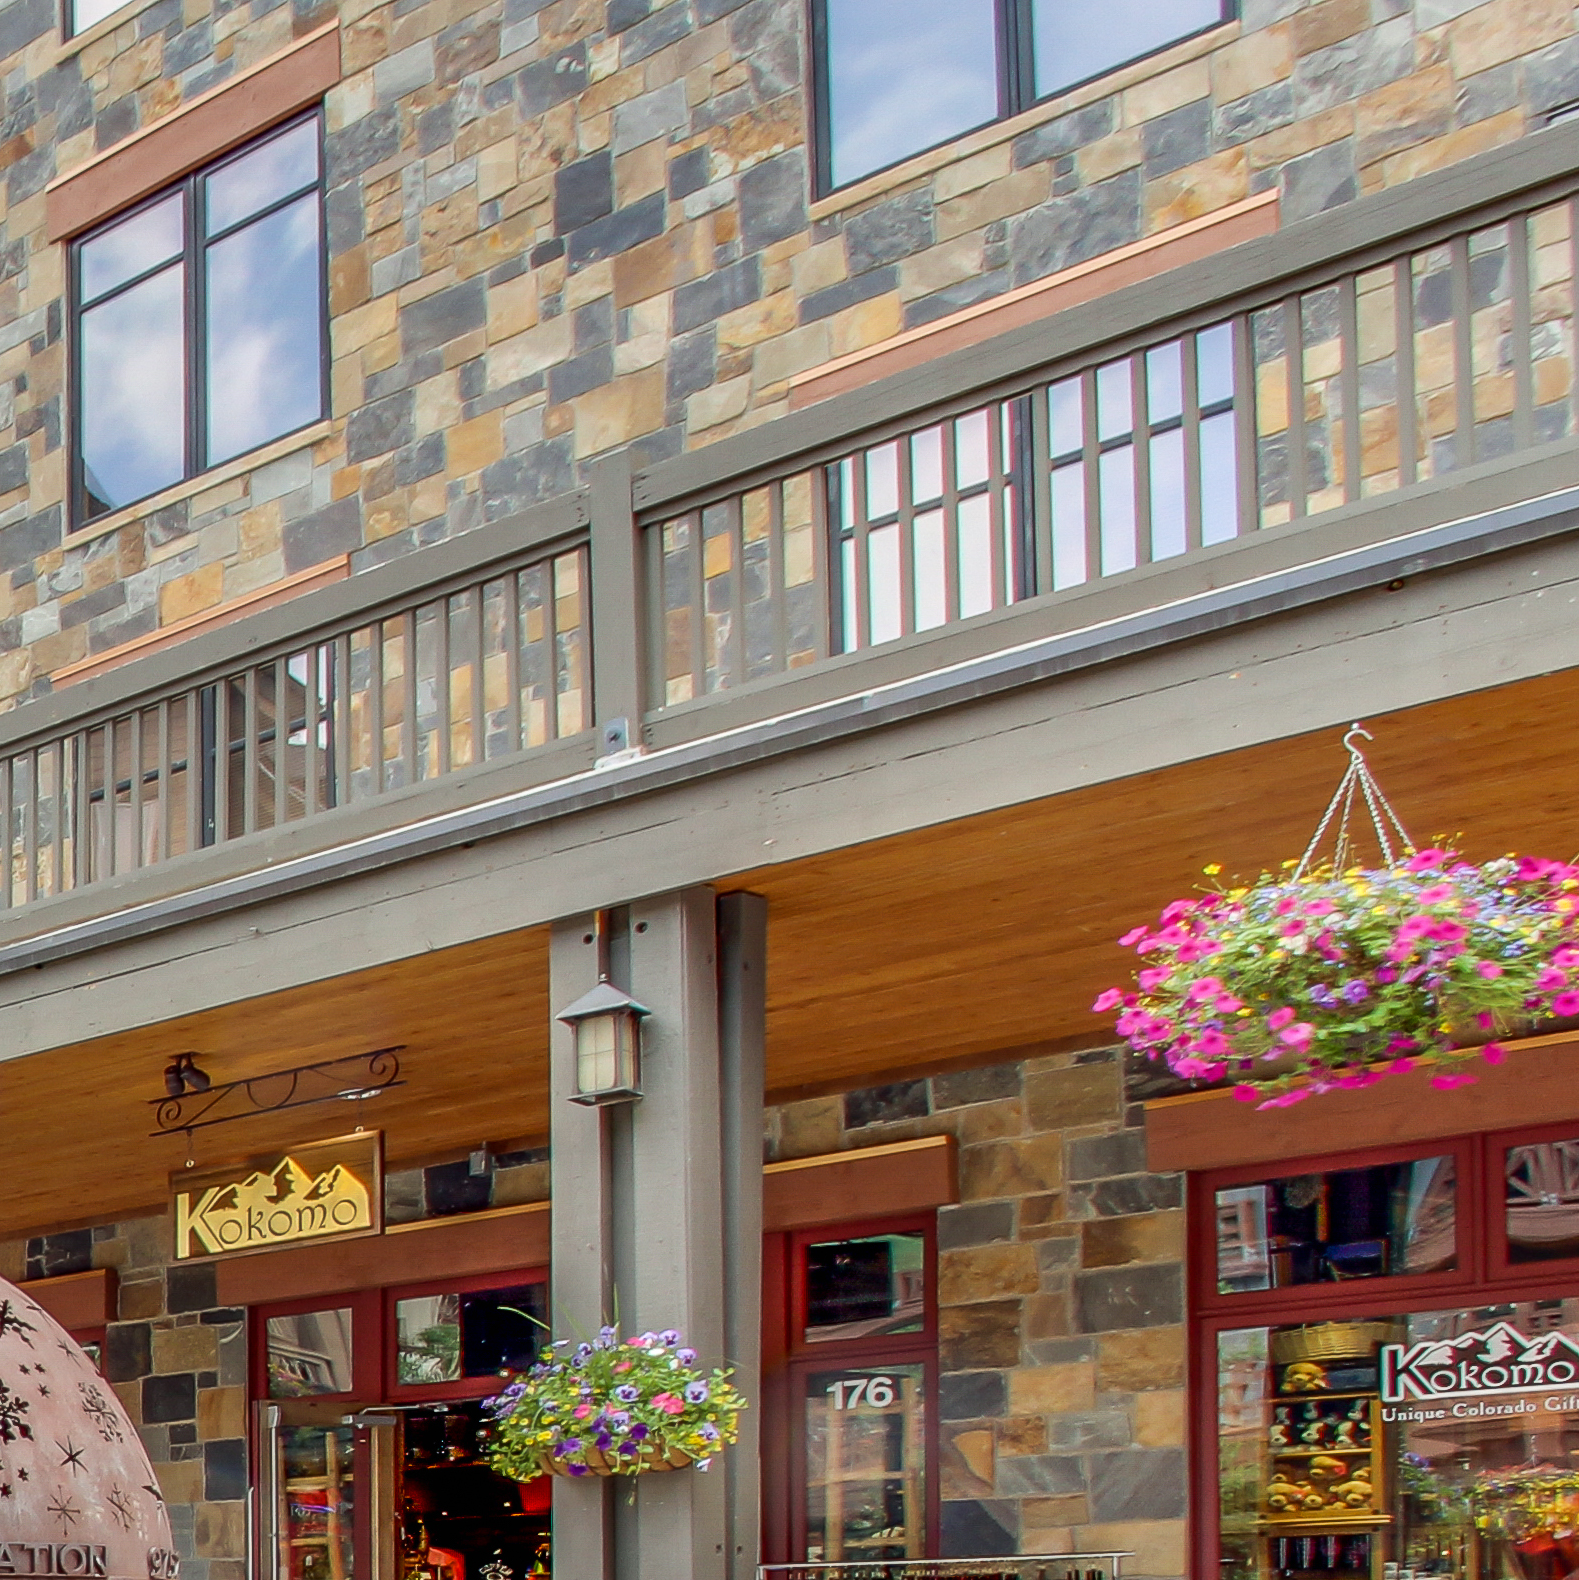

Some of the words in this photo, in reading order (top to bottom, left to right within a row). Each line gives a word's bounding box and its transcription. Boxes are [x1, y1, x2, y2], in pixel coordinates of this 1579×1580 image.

[176, 1186, 358, 1259] Kokomo
[826, 1376, 894, 1411] 176
[1381, 1342, 1576, 1403] Kokomo
[1381, 1407, 1446, 1424] Unique
[1452, 1399, 1537, 1418] Colorado
